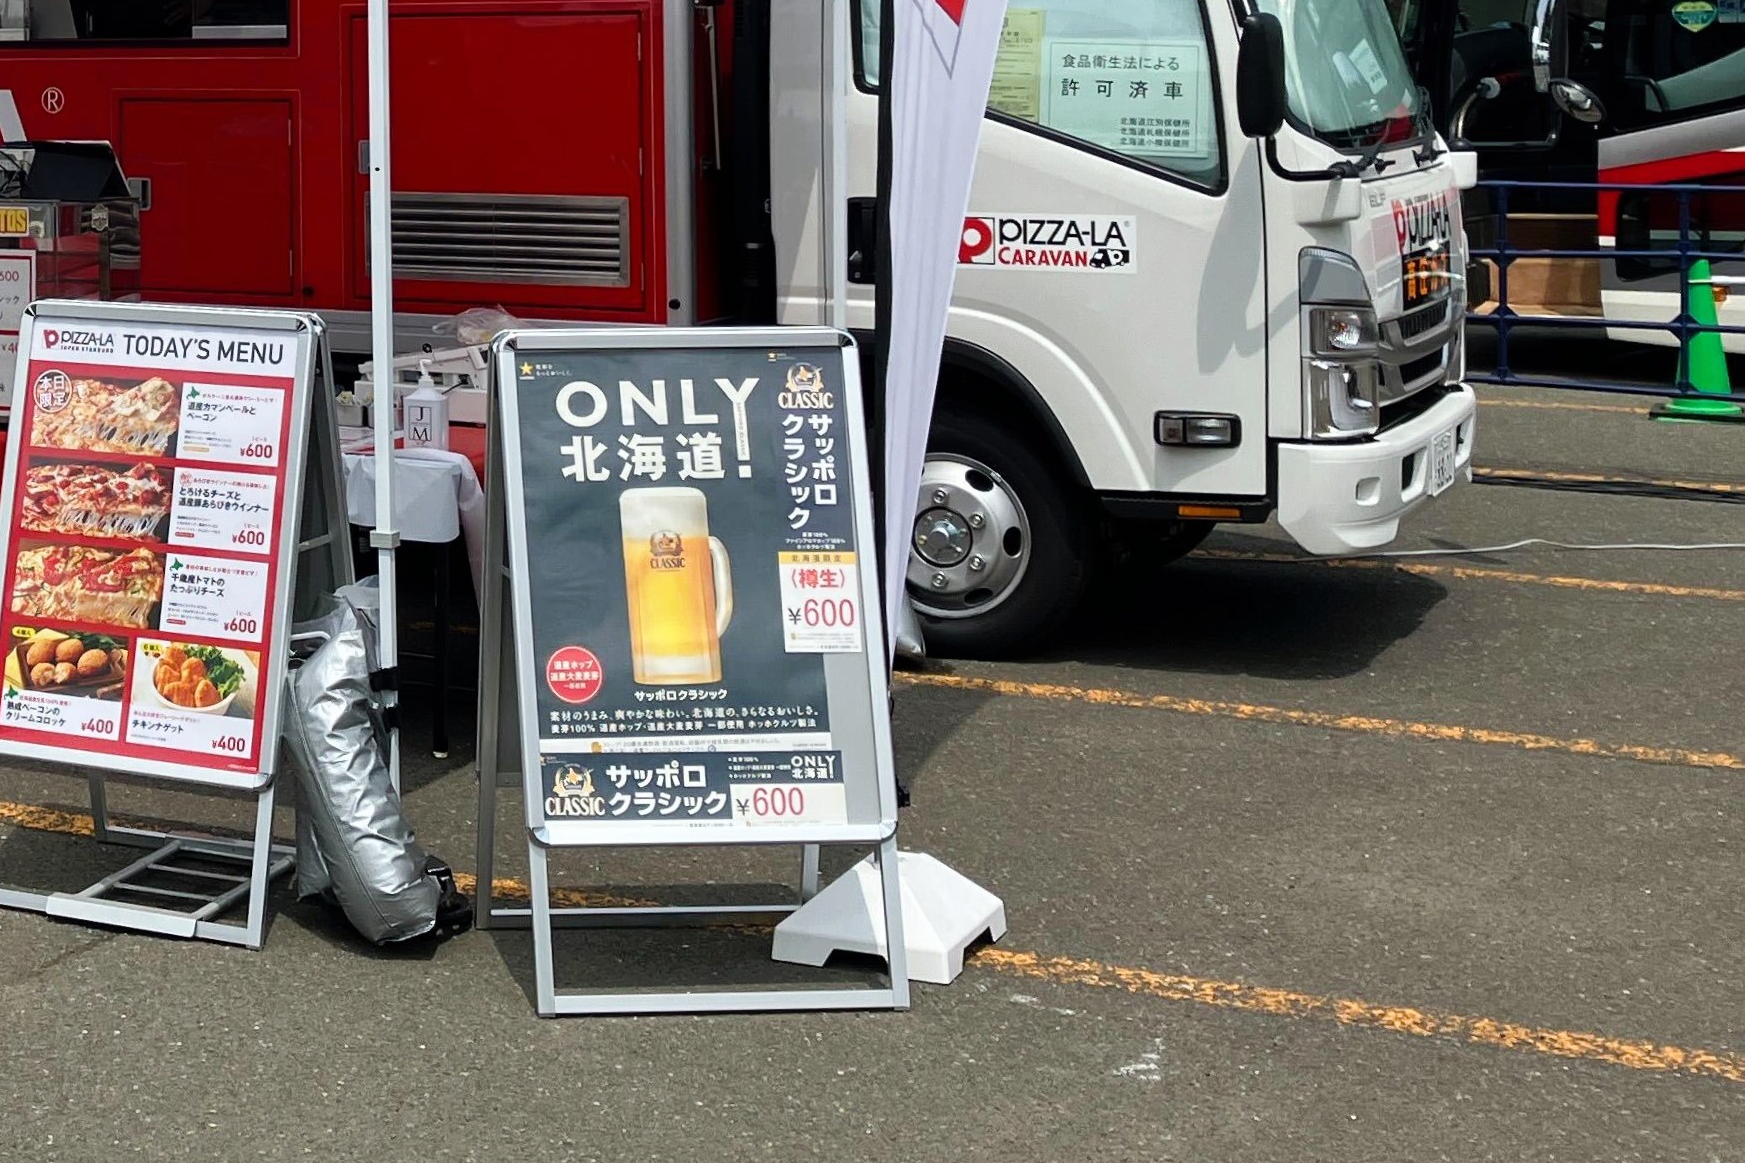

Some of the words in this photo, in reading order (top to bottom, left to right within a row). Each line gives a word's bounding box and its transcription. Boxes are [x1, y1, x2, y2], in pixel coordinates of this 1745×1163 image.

[1062, 53, 1180, 71] 食品衛生法による
[1061, 78, 1184, 100] 許可済車
[998, 218, 1127, 248] PIZZA-LA
[998, 247, 1089, 268] CARAVAN
[61, 330, 115, 347] PIZZA-LA
[123, 334, 211, 361] TODAY'S
[217, 340, 284, 365] MENU
[555, 377, 761, 429] ONLY
[777, 391, 835, 410] CLASSIC
[186, 412, 218, 423] ベーコン
[240, 443, 274, 459] ¥600
[808, 413, 838, 506] サッポロ
[781, 413, 811, 530] クラシック
[179, 486, 241, 501] とろけるチーズと
[232, 529, 265, 546] ¥600
[649, 557, 686, 570] CLASSIC
[169, 583, 225, 598] たっぷりチーズ
[787, 598, 856, 628] ¥600
[224, 617, 257, 634] ¥600
[634, 688, 728, 703] サッポロクラシック
[5, 711, 67, 727] クリームコロッケ
[81, 718, 114, 734] ¥400
[131, 719, 184, 734] チキンナゲット
[212, 735, 246, 752] ¥400
[790, 755, 836, 768] ONLY
[606, 760, 707, 789] サッポロ
[545, 796, 606, 817] CLASSIC
[608, 790, 728, 817] クラシック
[735, 786, 805, 817] ¥600
